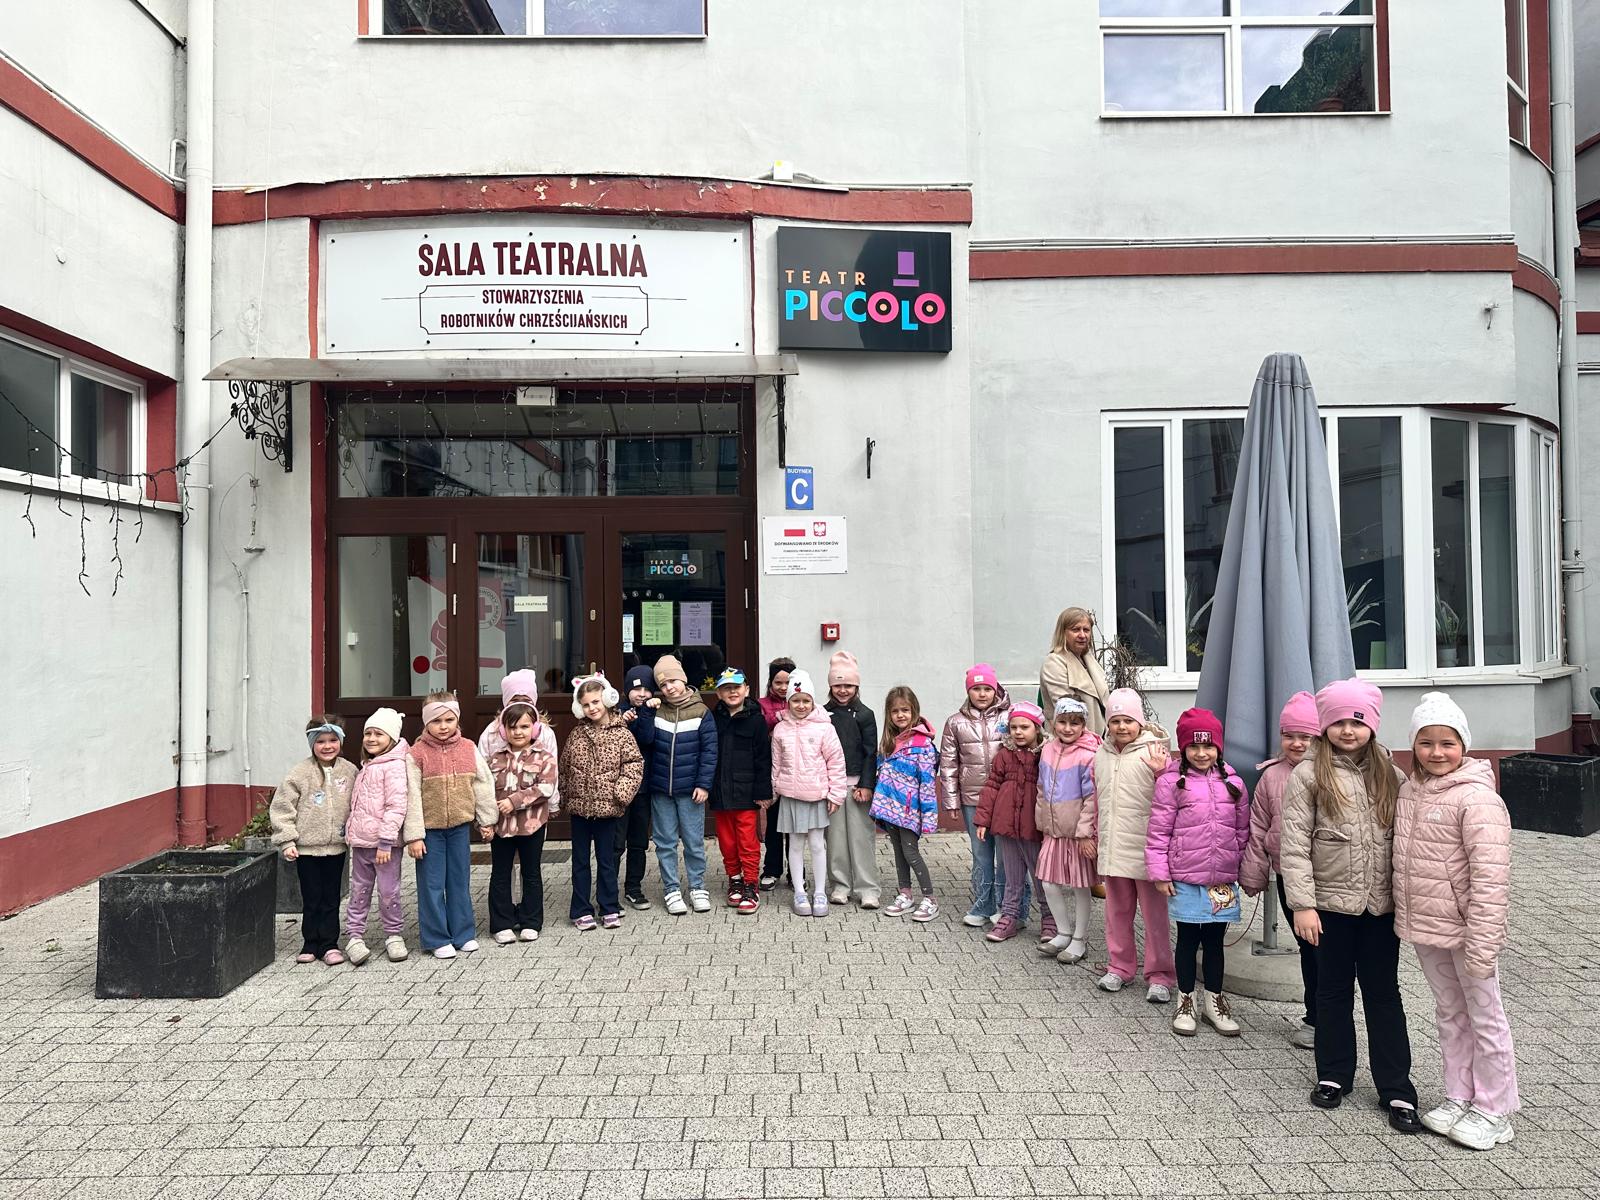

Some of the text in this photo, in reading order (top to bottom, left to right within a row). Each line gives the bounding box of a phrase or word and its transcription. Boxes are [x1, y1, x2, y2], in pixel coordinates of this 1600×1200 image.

[418, 241, 648, 278] SALA TEATRALNA
[784, 269, 866, 286] TEATR
[482, 289, 584, 305] STOWARZYSZENIA
[440, 307, 628, 329] ROBOTNIKÓW CHRZEŚCIJAŃSKICH
[785, 289, 946, 331] PICCOLO
[791, 478, 809, 505] C
[650, 565, 697, 576] PICCOLO
